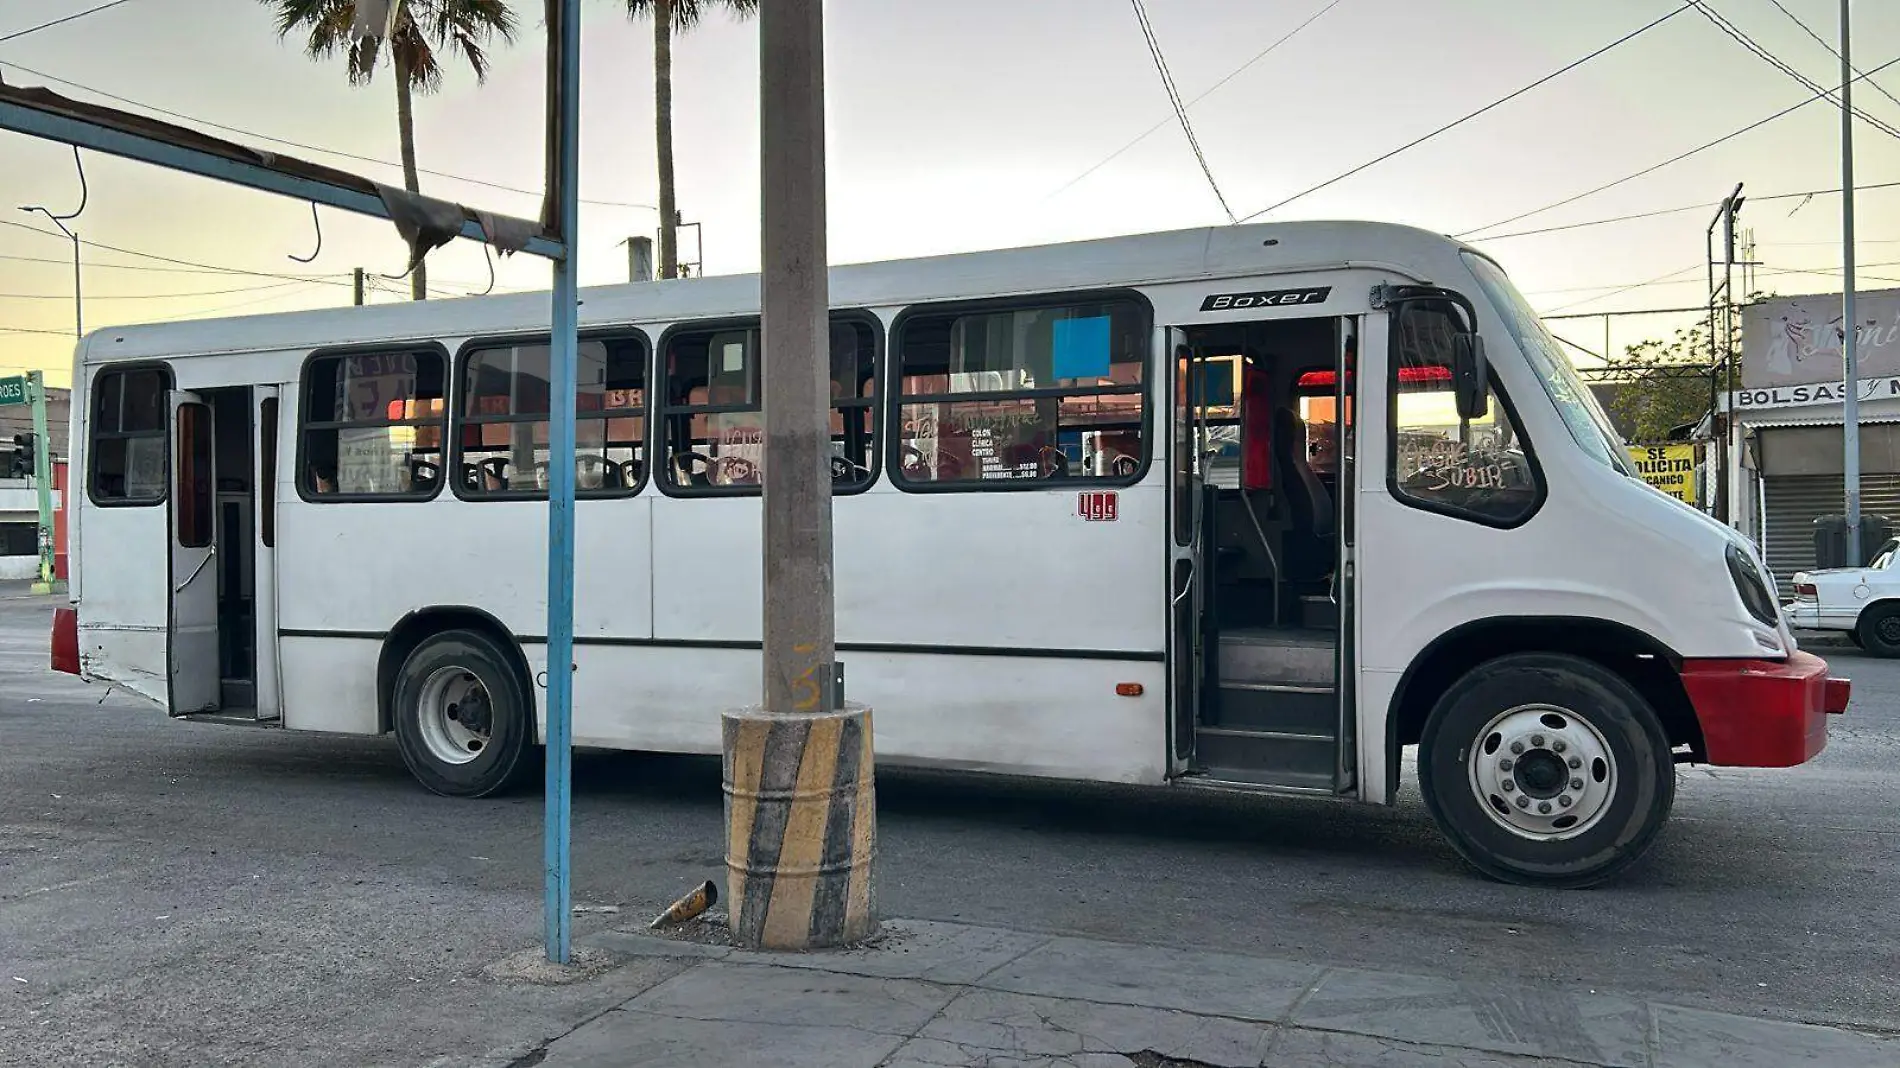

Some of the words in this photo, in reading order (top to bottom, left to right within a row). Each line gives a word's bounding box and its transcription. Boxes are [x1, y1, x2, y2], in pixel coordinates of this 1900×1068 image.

[1212, 292, 1318, 308] Boxer
[971, 447, 995, 457] CENTRO
[1647, 447, 1667, 460] SE
[1634, 458, 1692, 473] OLICITA
[1643, 474, 1684, 485] CANICO
[1077, 490, 1120, 521] 499
